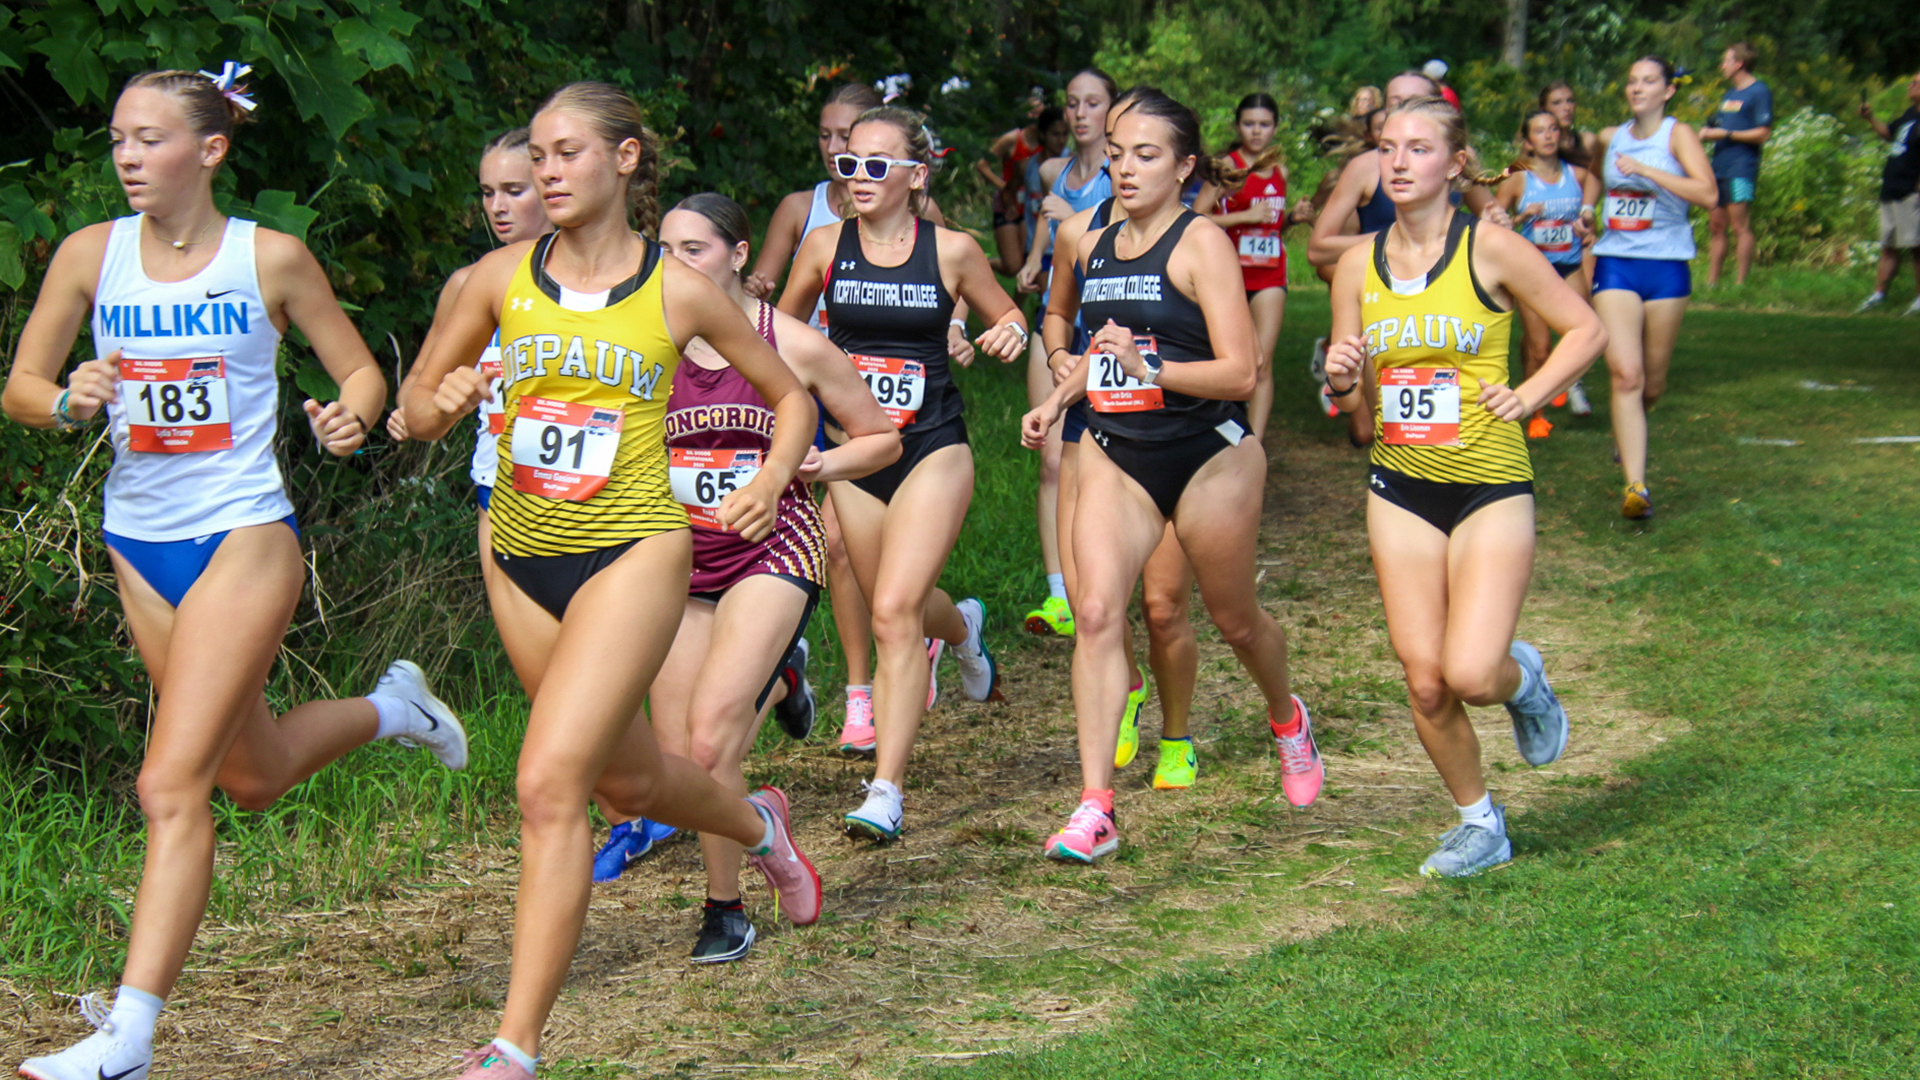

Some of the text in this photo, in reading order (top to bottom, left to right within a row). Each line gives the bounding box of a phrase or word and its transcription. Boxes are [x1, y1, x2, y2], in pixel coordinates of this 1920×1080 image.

[1615, 199, 1649, 216] 207
[1249, 238, 1274, 254] 141
[1542, 228, 1567, 242] 120
[834, 280, 938, 308] NORTH CENTRAL COLLEGE
[1126, 275, 1162, 301] COLLEGE
[100, 302, 249, 338] MILLIKIN
[1364, 314, 1484, 358] EPAUW
[503, 334, 664, 401] DEPAUW
[139, 384, 211, 424] 183
[1399, 388, 1435, 419] 95
[664, 404, 776, 441] ONCORDIA
[539, 425, 586, 469] 91
[695, 471, 737, 505] 65
